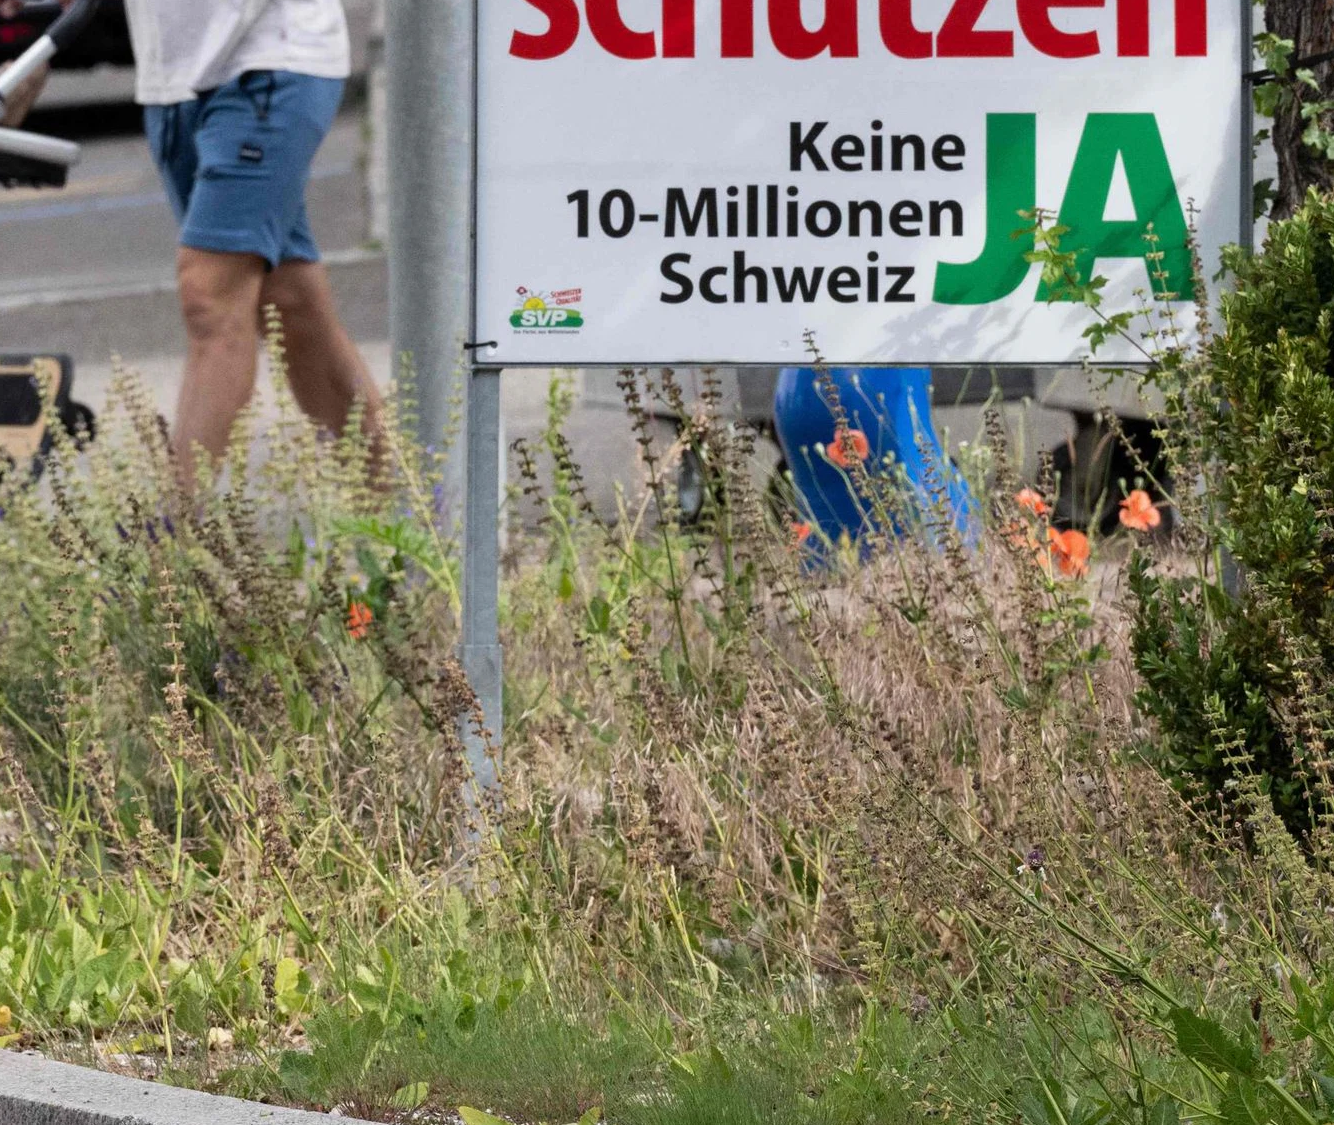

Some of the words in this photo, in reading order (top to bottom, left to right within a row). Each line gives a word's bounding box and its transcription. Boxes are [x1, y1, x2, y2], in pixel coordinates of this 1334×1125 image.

[790, 120, 966, 173] Keine
[567, 185, 964, 239] 10-Millionen
[932, 112, 1197, 306] JA
[659, 250, 916, 305] Schweiz
[520, 309, 568, 327] SVP
